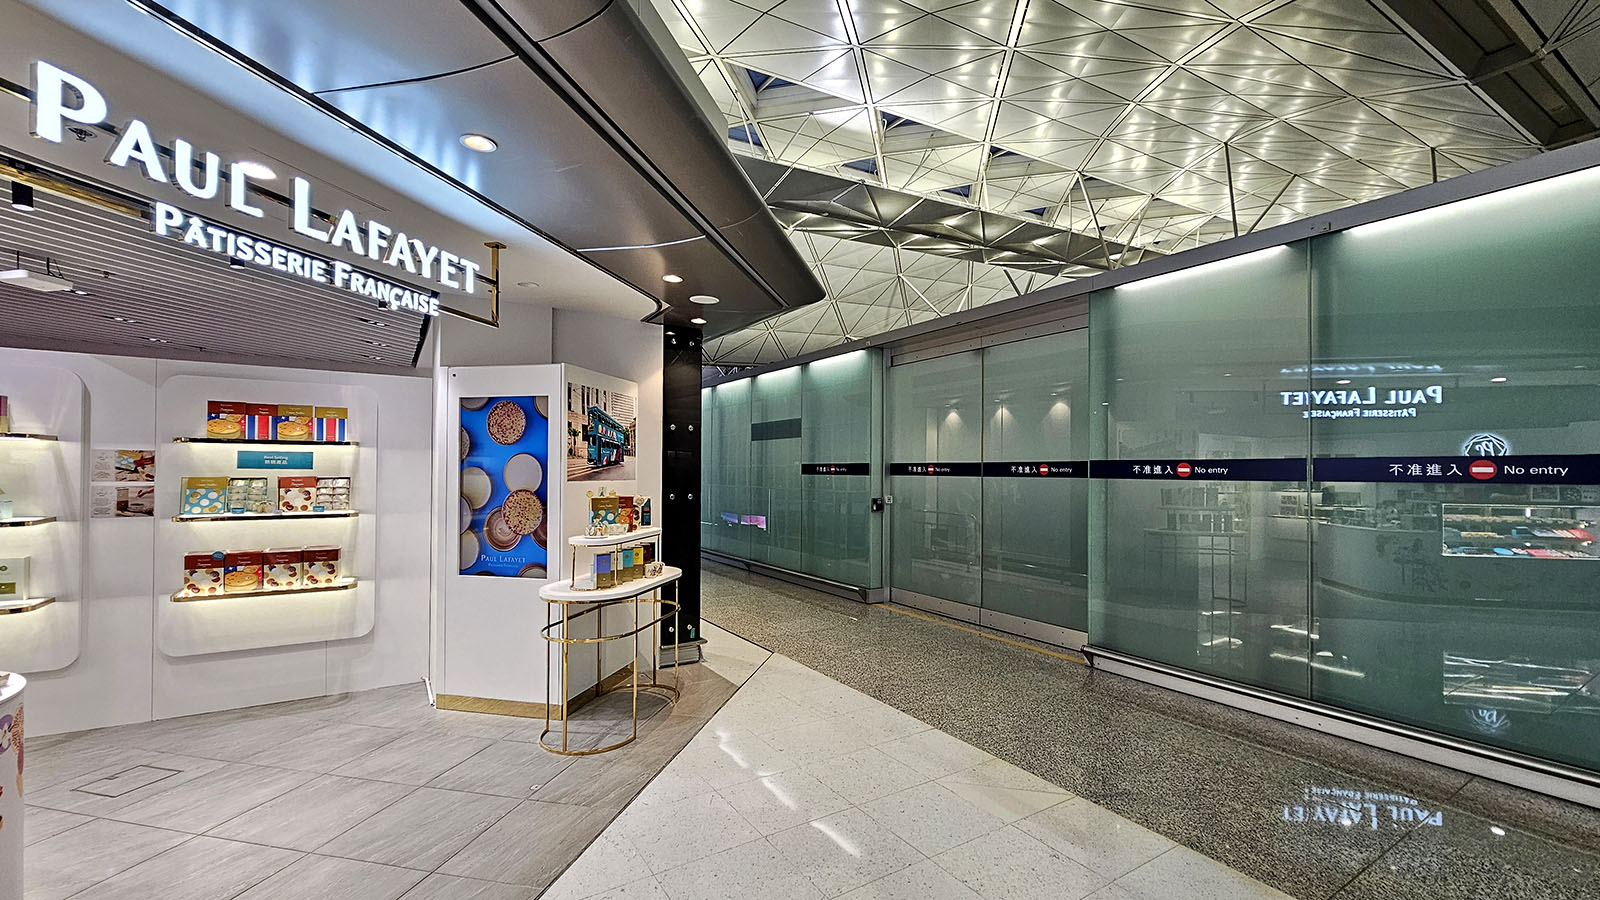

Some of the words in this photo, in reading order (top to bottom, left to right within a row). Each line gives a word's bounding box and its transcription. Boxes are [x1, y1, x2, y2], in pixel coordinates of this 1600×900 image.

[35, 59, 265, 218] PAUL
[293, 176, 480, 294] LAFAYET
[155, 201, 328, 282] PÂTISSERIE
[333, 260, 440, 316] FRANÇAISE
[1010, 465, 1038, 474] 不准進入
[1132, 465, 1174, 475] 不准進入
[1194, 466, 1207, 474] No
[1207, 466, 1229, 476] entry
[1389, 463, 1463, 477] 不准進入
[1504, 465, 1525, 475] No
[1529, 465, 1569, 477] entry
